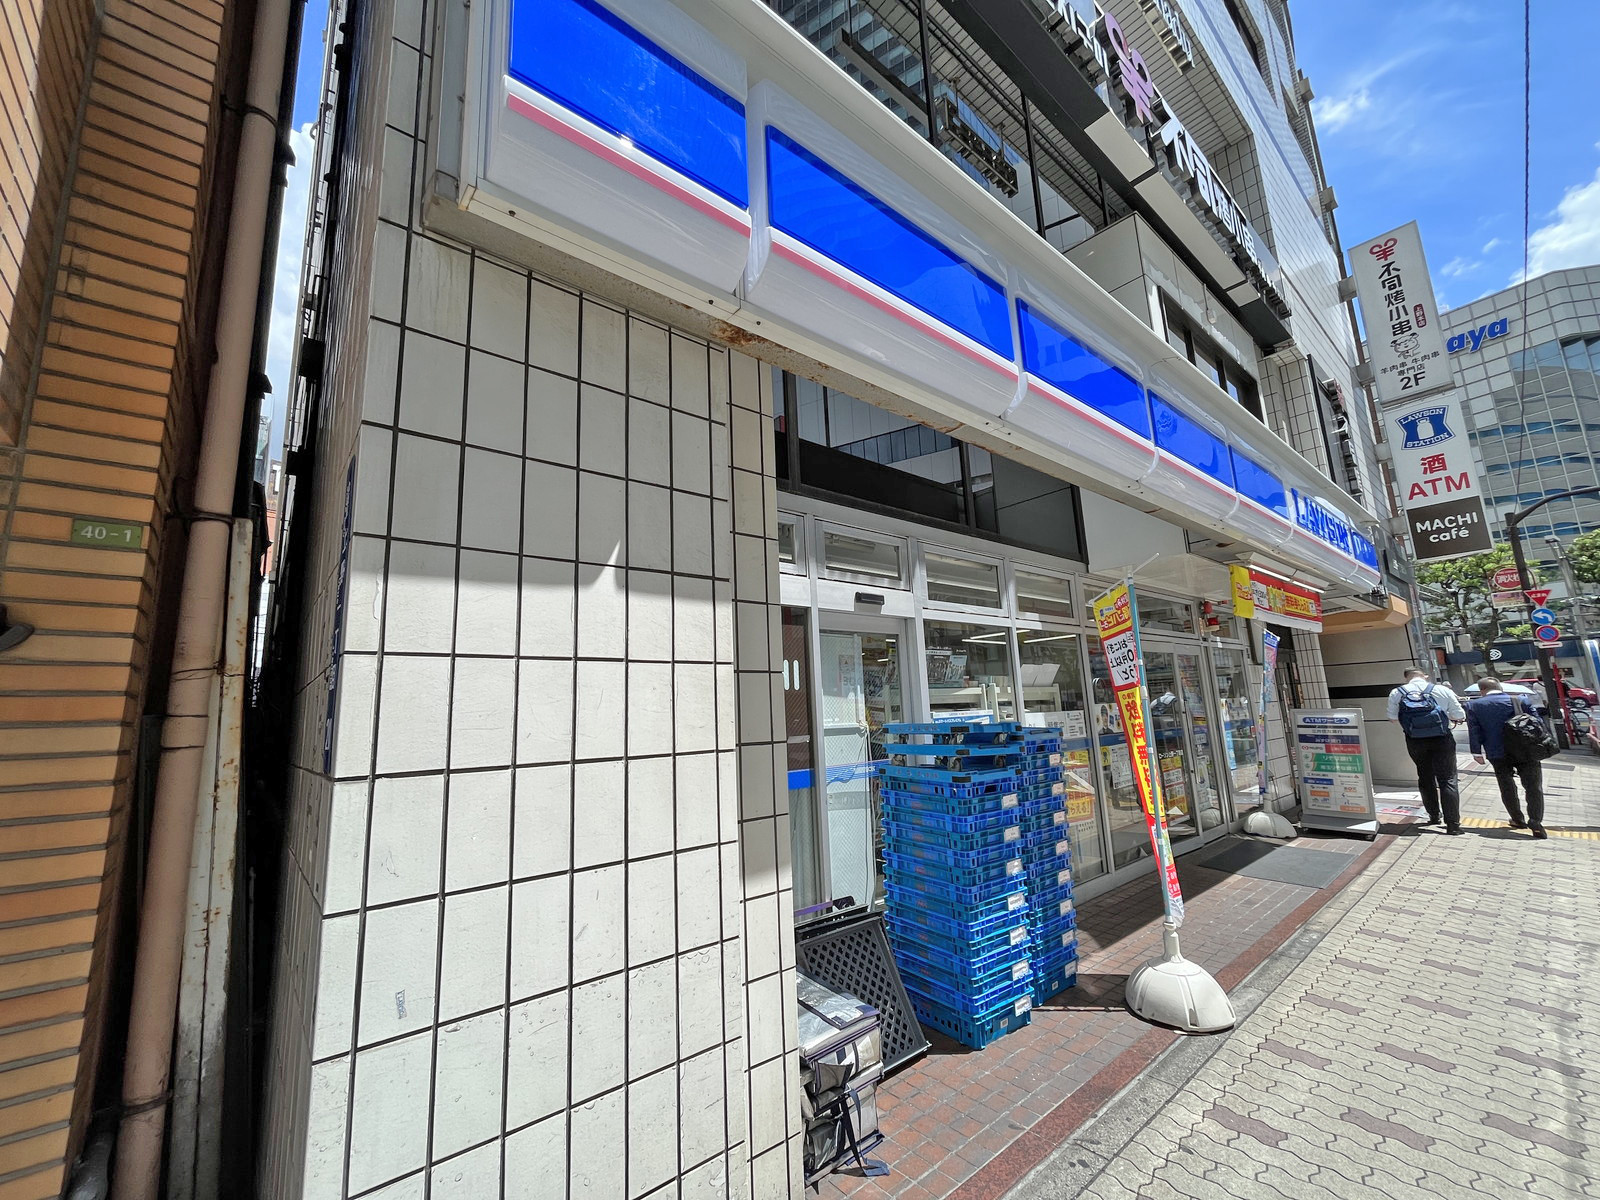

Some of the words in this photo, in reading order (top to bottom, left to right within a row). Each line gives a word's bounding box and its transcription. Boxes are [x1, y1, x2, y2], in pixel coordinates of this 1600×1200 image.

[1400, 371, 1425, 390] 2F
[1400, 408, 1443, 424] LAWSON
[1406, 432, 1449, 448] STATION
[1420, 453, 1447, 475] 酒
[1408, 472, 1471, 500] ATM
[1415, 512, 1478, 533] MACHI
[1429, 526, 1470, 543] café
